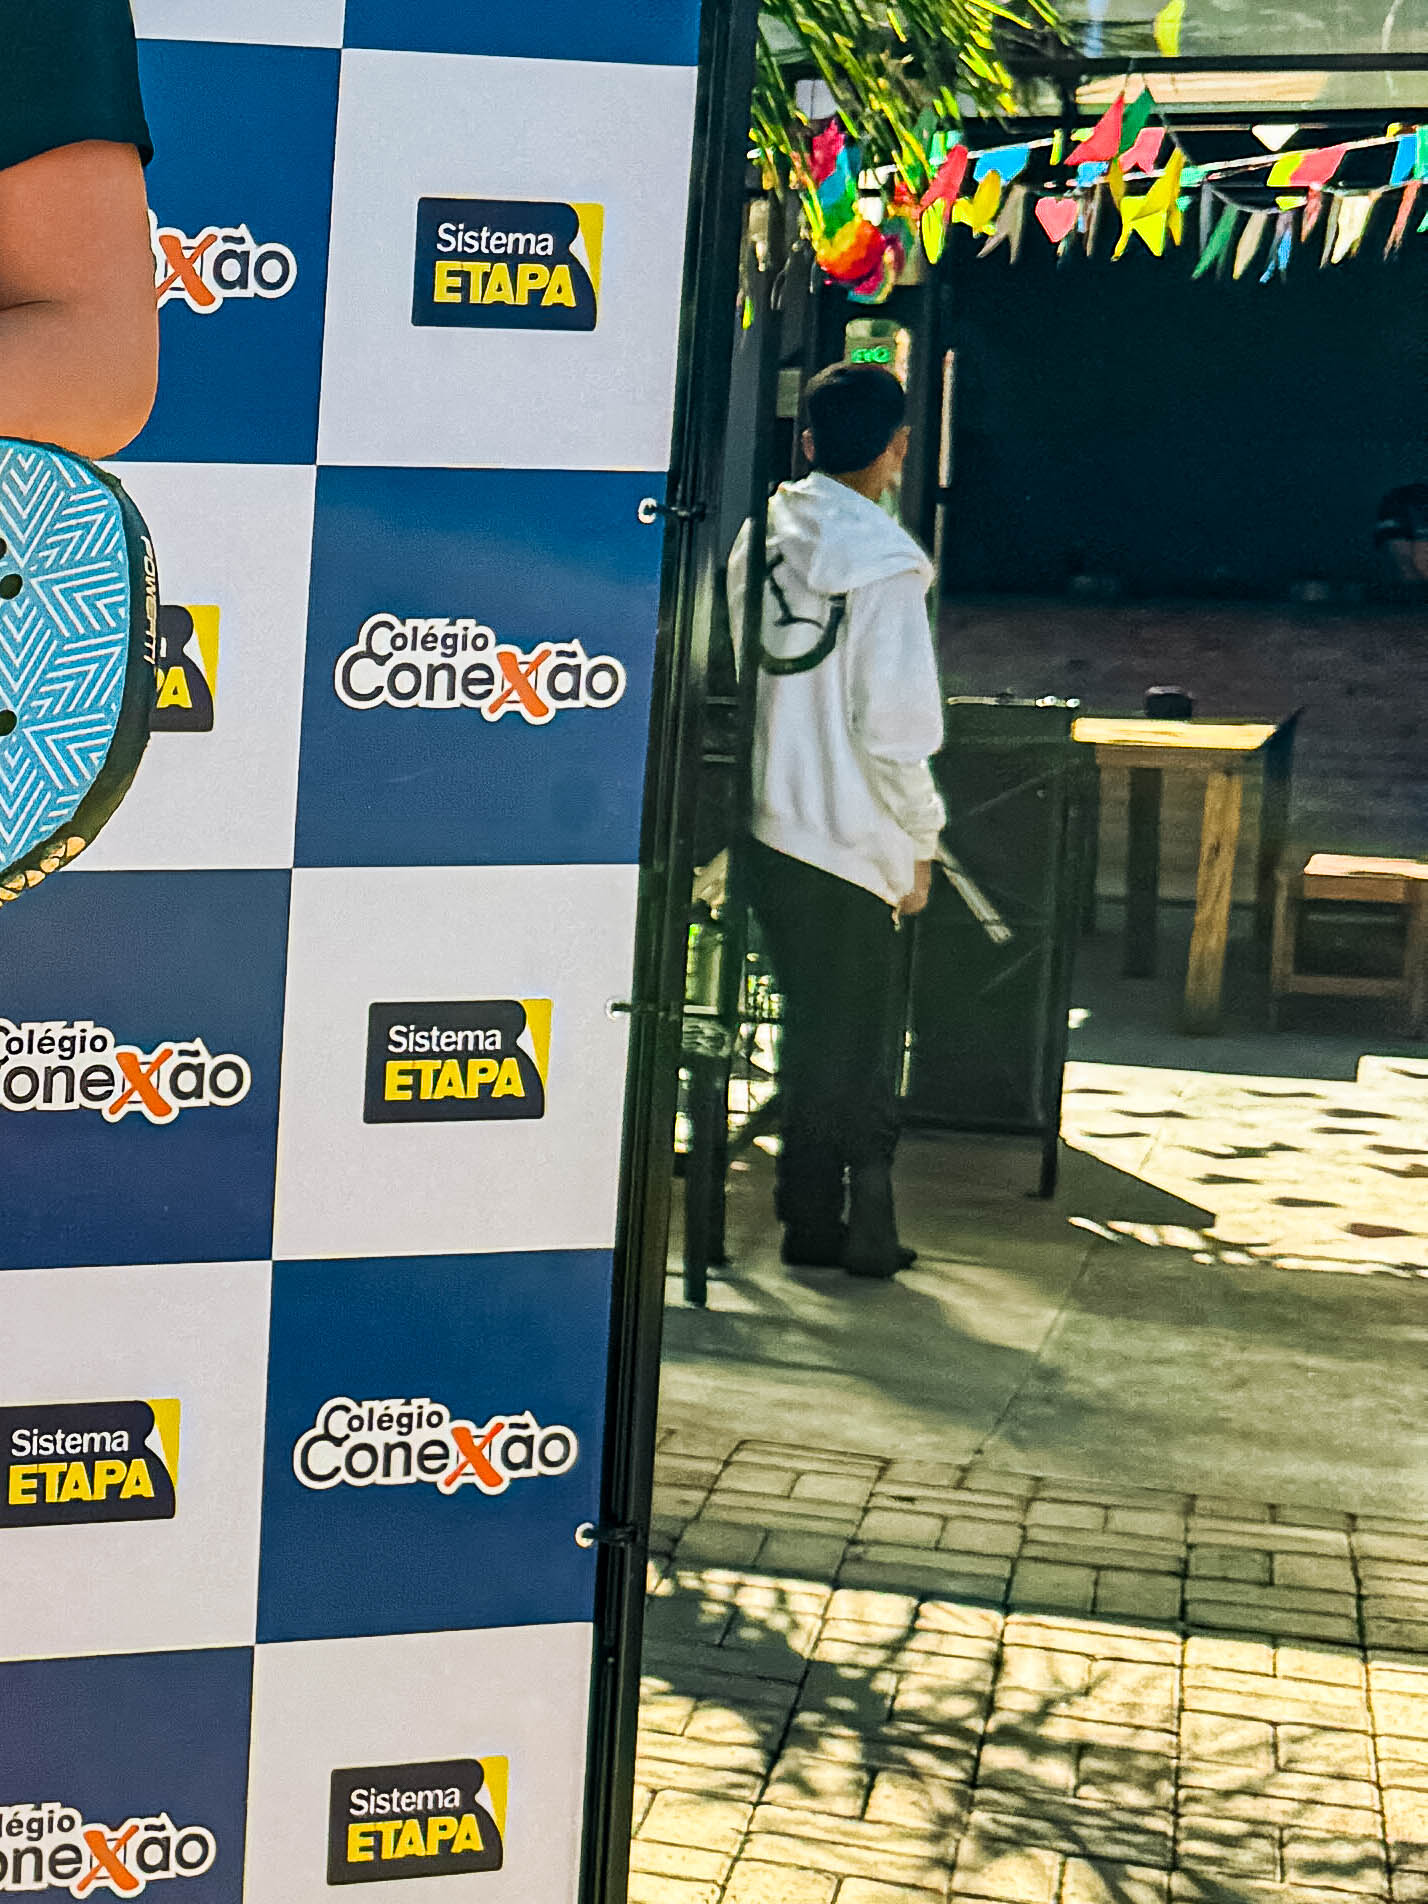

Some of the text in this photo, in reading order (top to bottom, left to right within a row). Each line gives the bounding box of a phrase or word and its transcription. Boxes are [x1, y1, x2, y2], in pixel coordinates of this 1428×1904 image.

[436, 223, 554, 259] Sistema
[434, 259, 575, 308] ETAPA
[369, 623, 490, 662] Colégio
[389, 1024, 502, 1055] Sistema
[385, 1057, 525, 1101] ETAPA
[326, 1404, 444, 1442] Colégio
[11, 1427, 129, 1458] Sistema
[9, 1458, 154, 1505] ETAPA
[349, 1784, 461, 1816] Sistema
[347, 1815, 485, 1863] ETAPA
